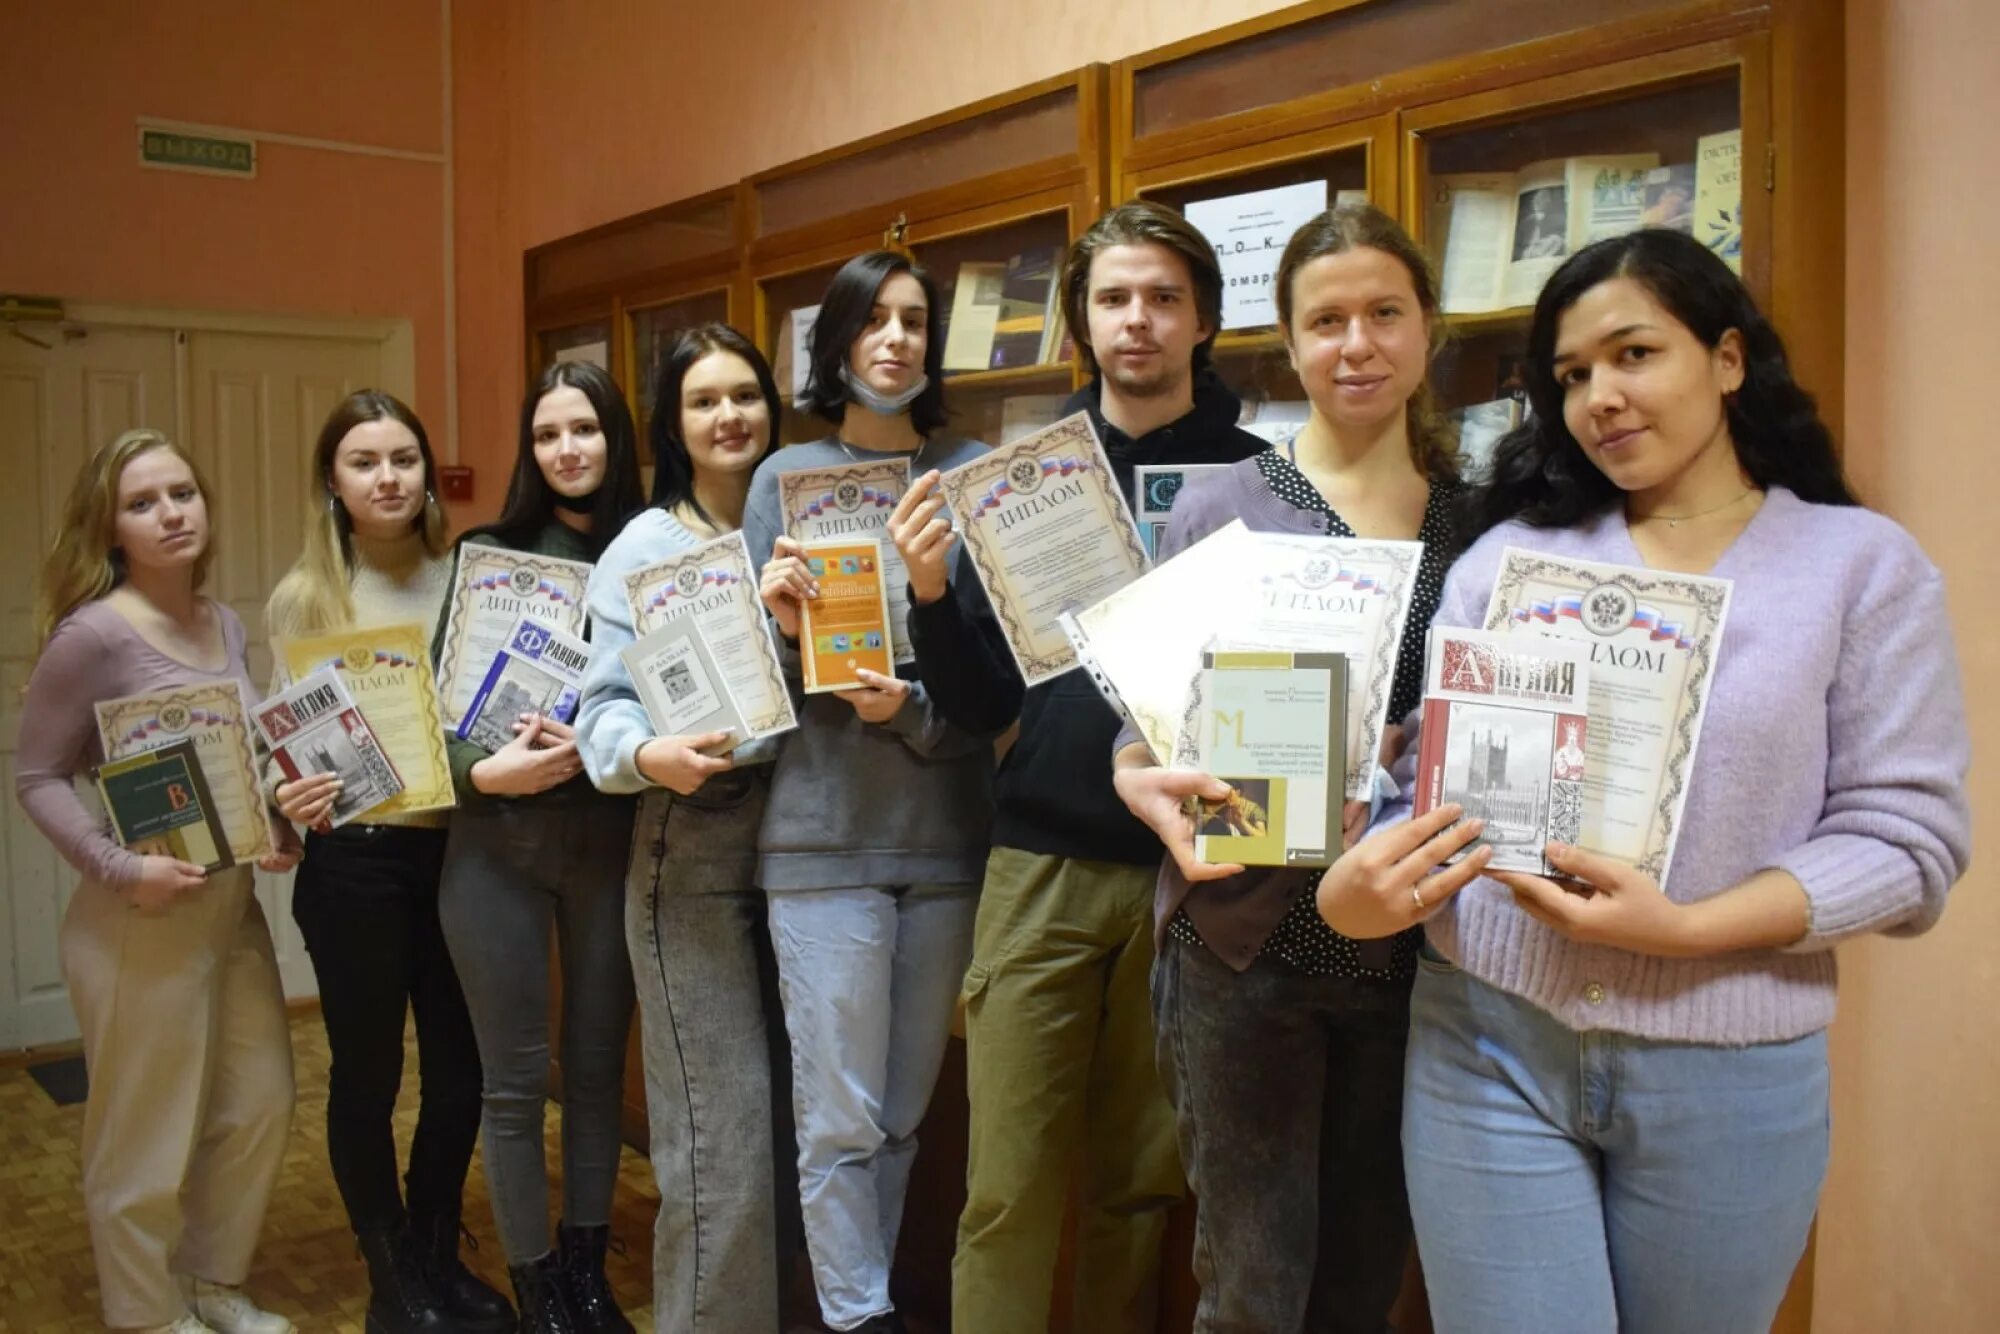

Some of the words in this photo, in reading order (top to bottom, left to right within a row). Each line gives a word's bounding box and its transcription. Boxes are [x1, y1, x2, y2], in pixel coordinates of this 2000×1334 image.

[146, 137, 249, 166] ВЫХОД
[996, 479, 1085, 534] ДИПЛОМ
[813, 513, 889, 539] ДИПЛОМ
[480, 595, 560, 621] ДИПЛОМ
[1265, 591, 1368, 614] ПЛОМ
[518, 630, 588, 672] ФРАНЦИЯ
[1578, 639, 1666, 674] ЛОМ
[264, 683, 339, 739] АНГЛИЯ
